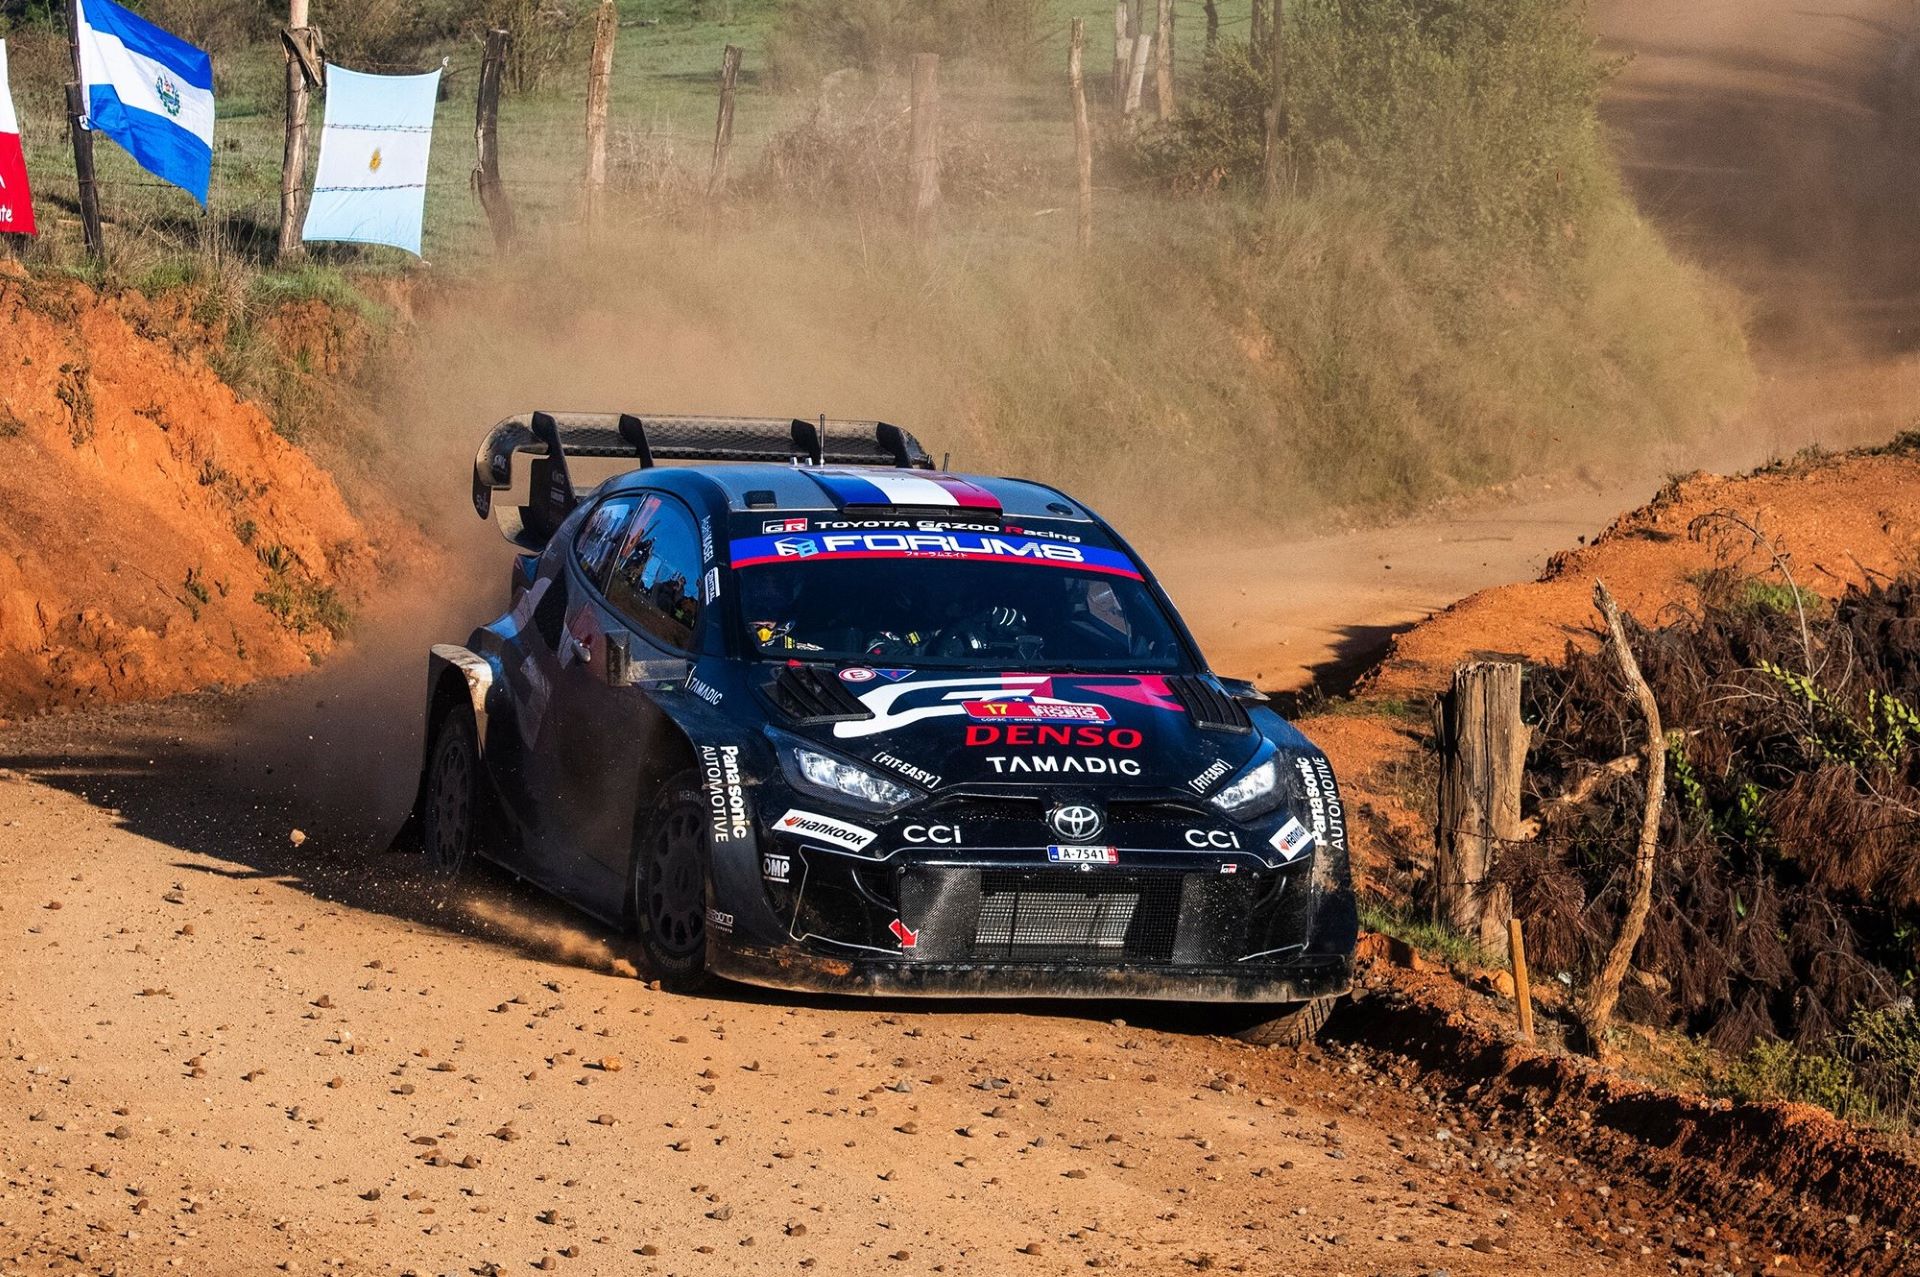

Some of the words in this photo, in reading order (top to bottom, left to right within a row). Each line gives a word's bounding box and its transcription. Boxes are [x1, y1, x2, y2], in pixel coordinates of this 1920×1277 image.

[814, 521, 911, 529] TOYOTA
[916, 521, 1000, 532] GAZOO
[1004, 524, 1081, 543] Racing
[822, 535, 1085, 562] FORUM8
[688, 677, 723, 706] TAMADIC
[983, 703, 1008, 715] 17
[966, 725, 1143, 749] DENSO
[986, 756, 1141, 776] TAMADIC
[701, 745, 728, 842] AUTOMOTIVE
[720, 746, 750, 838] Panasonic
[1296, 757, 1328, 846] Panasonic
[1312, 757, 1344, 850] AUTOMOTIVE
[1063, 848, 1104, 860] A-7541
[763, 857, 790, 877] OMP
